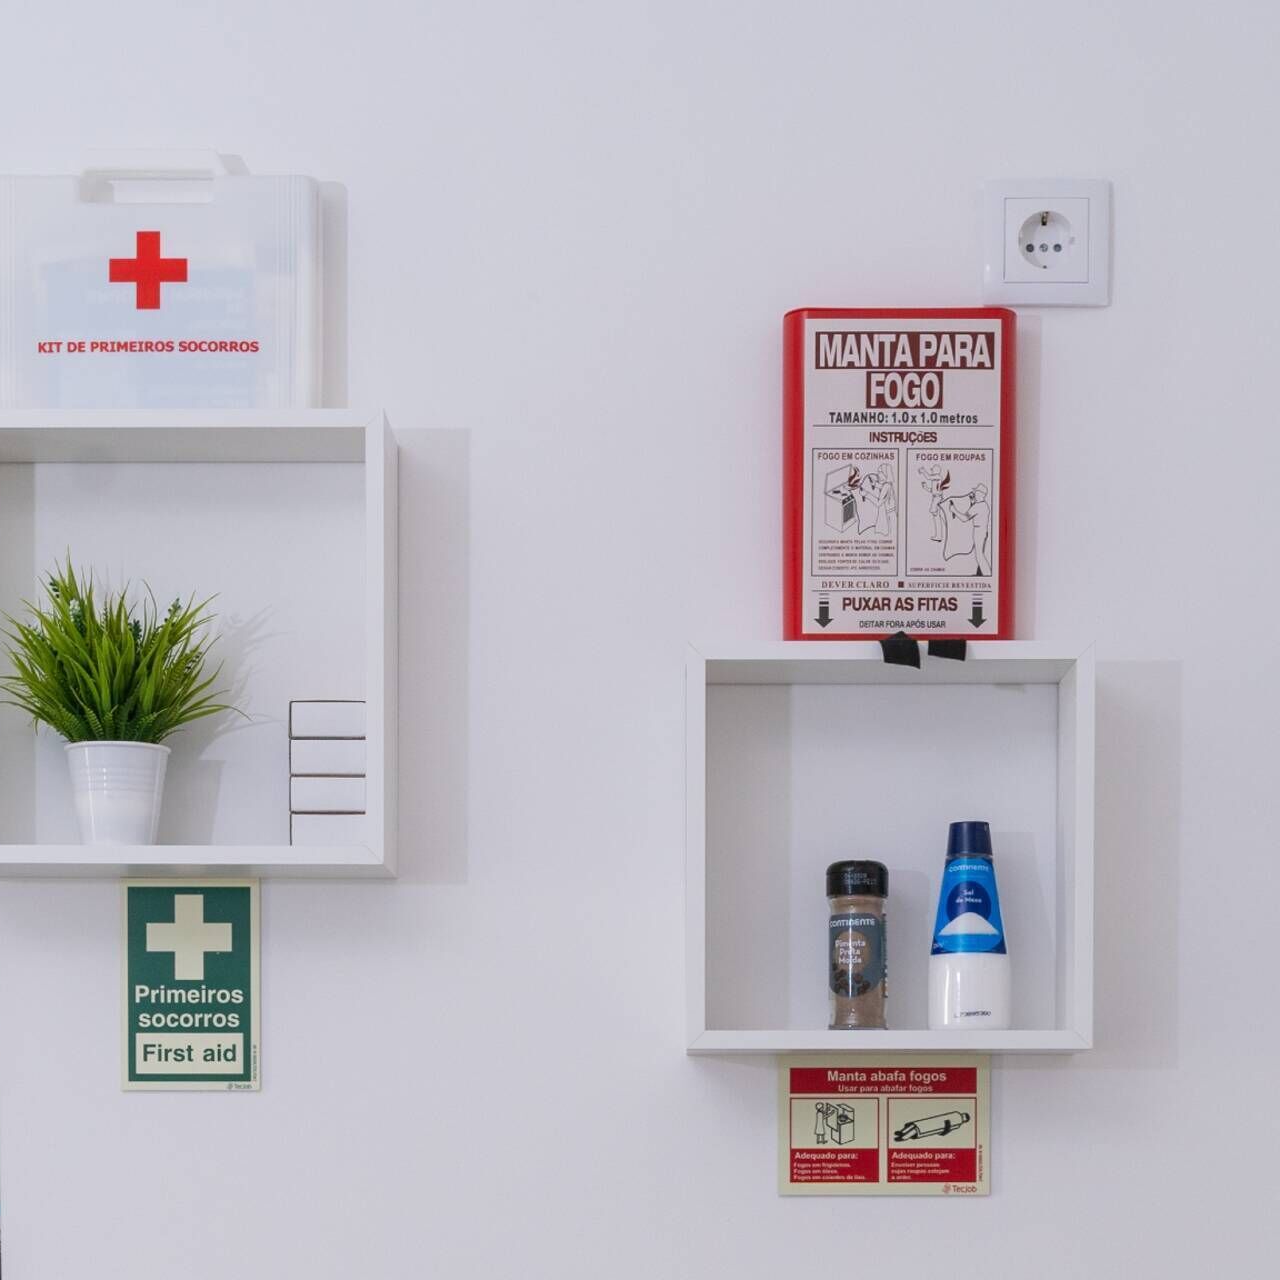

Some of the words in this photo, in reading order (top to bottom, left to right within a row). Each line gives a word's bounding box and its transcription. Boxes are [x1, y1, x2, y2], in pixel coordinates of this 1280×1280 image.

[37, 341, 63, 353] KIT
[67, 341, 86, 352] DE
[90, 340, 175, 352] PRIMEIROS
[178, 340, 260, 353] SOCORROS
[819, 333, 914, 368] MANTA
[919, 333, 992, 368] PARA
[869, 371, 941, 408] FOGO
[828, 412, 889, 424] TAMANHO:
[891, 412, 909, 424] 1.0
[910, 414, 918, 424] x
[920, 412, 938, 424] 1.0
[939, 412, 979, 424] metros
[817, 452, 840, 460] FOGO
[841, 452, 853, 460] EM
[854, 452, 895, 460] COZINHAS
[915, 453, 938, 461] FOGO
[940, 453, 952, 461] EM
[953, 453, 986, 461] ROUPAS
[821, 580, 855, 589] DEVER
[856, 580, 890, 589] CLARO
[951, 581, 992, 589] REVESTIDA
[841, 596, 894, 612] PUXAR
[894, 596, 915, 612] AS
[917, 596, 958, 612] FITAS
[859, 619, 885, 629] DEITAR
[885, 619, 905, 629] FORA
[905, 618, 926, 629] APÓS
[926, 619, 946, 629] USAR
[135, 985, 244, 1004] Primeiros
[138, 1012, 240, 1028] socorros
[142, 1043, 194, 1063] First
[202, 1043, 237, 1063] aid
[827, 1070, 866, 1082] Manta
[870, 1070, 906, 1082] abafa
[910, 1070, 947, 1085] fogos
[837, 1084, 859, 1092] Usar
[860, 1085, 879, 1093] para
[880, 1084, 908, 1092] abafar
[909, 1084, 933, 1093] fogos
[794, 1151, 835, 1161] Adequado
[837, 1153, 858, 1161] para:
[891, 1151, 932, 1161] Adequado
[934, 1153, 956, 1161] para:
